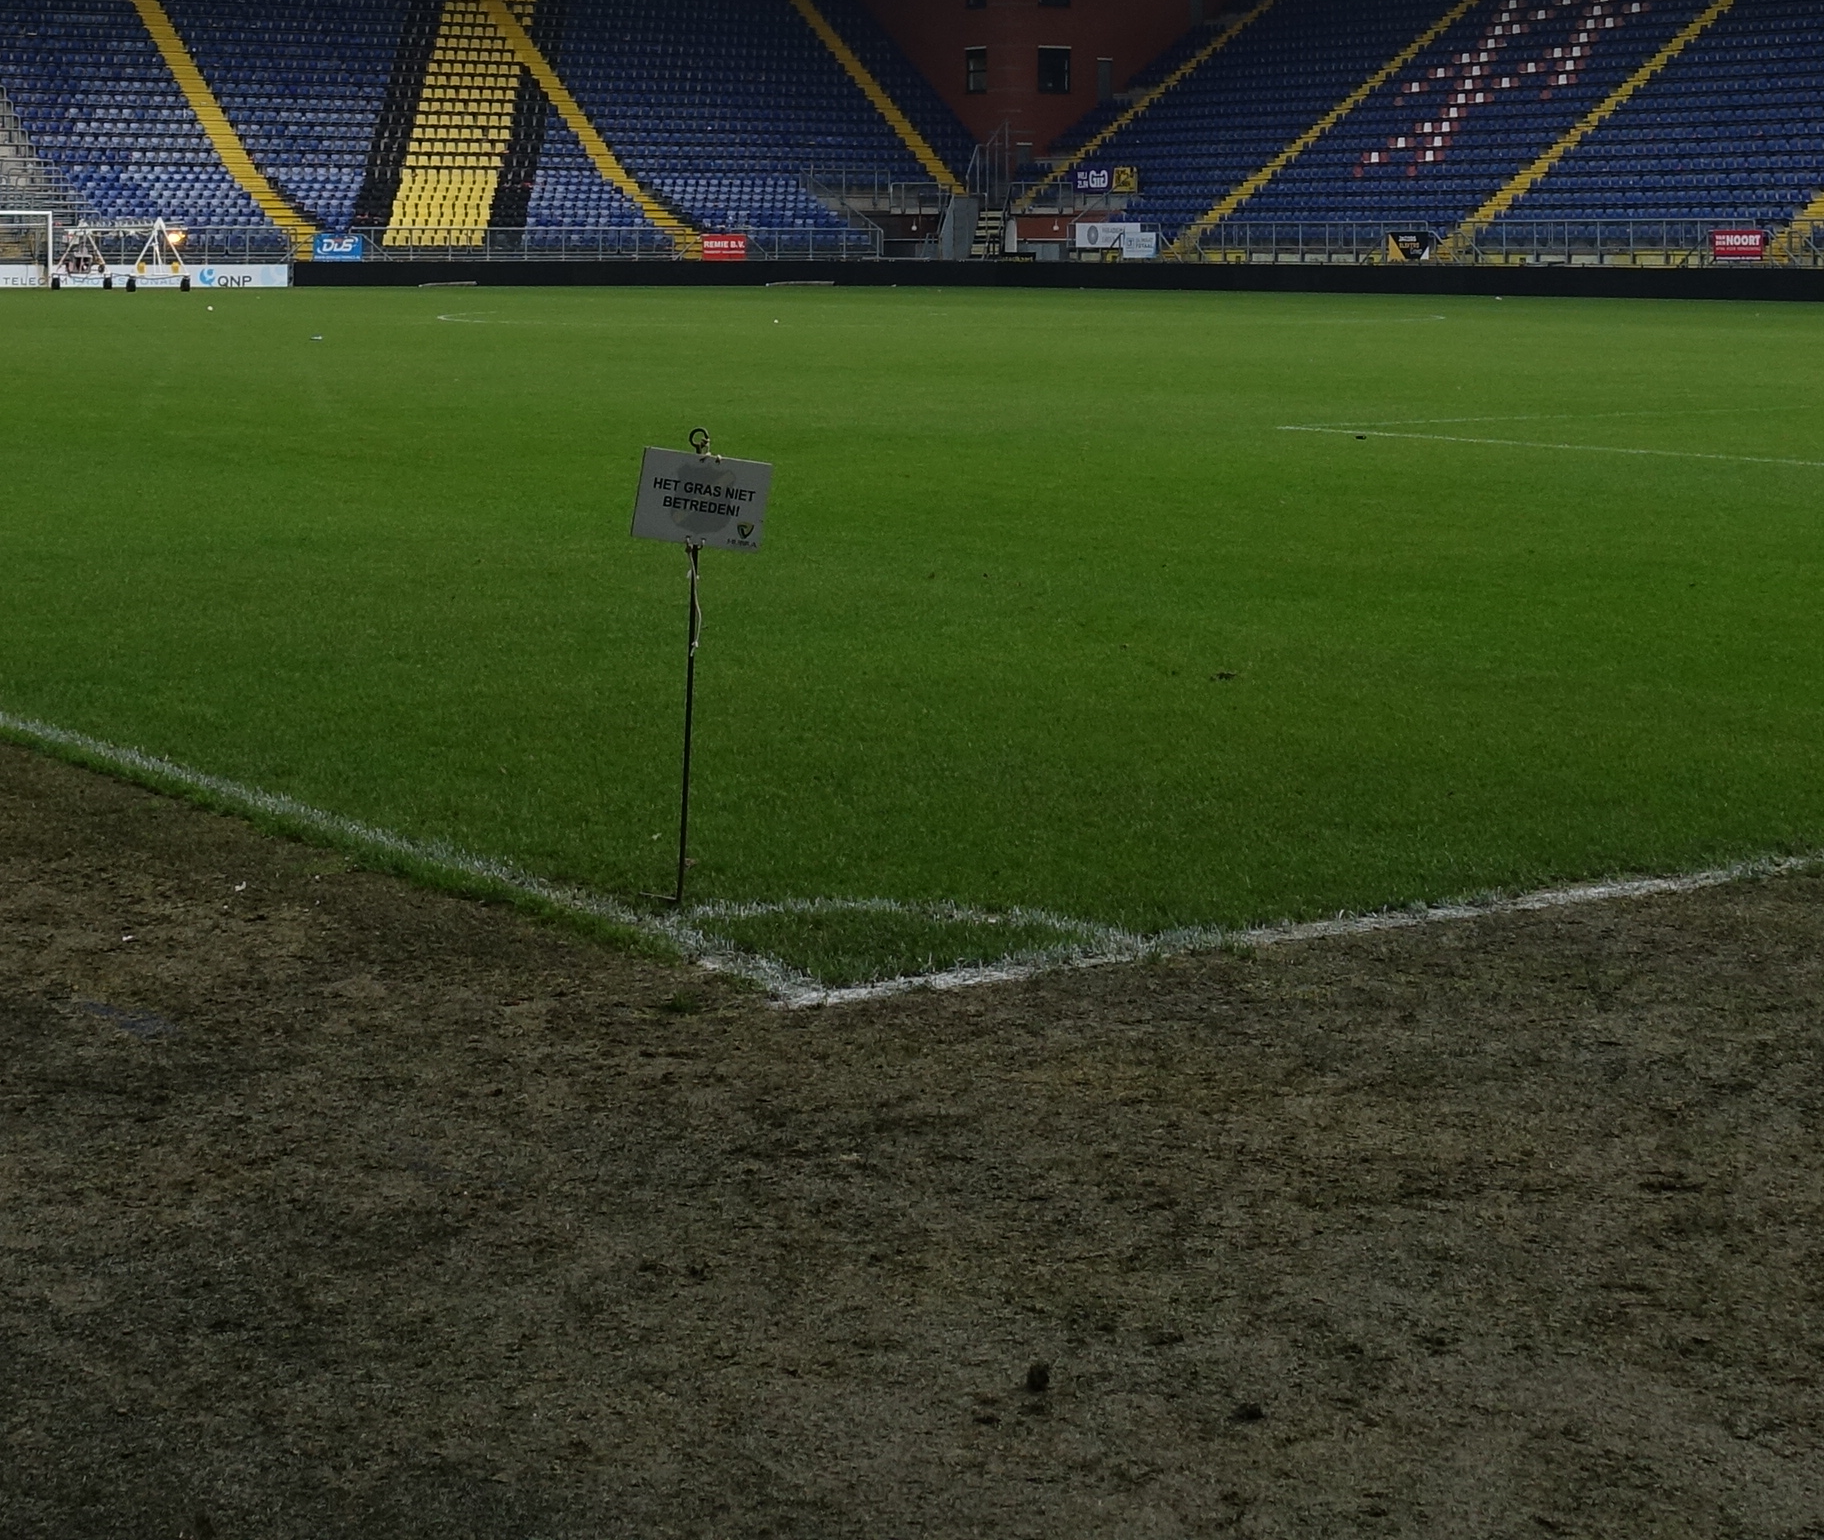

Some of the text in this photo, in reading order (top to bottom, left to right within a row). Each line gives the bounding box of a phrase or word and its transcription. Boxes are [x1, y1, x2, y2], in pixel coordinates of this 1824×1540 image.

[1726, 234, 1761, 246] NOORT
[2, 277, 68, 286] TELECM
[217, 275, 252, 288] QNP
[653, 477, 756, 502] HET GRAS NIET
[662, 495, 741, 517] BETREDEN!
